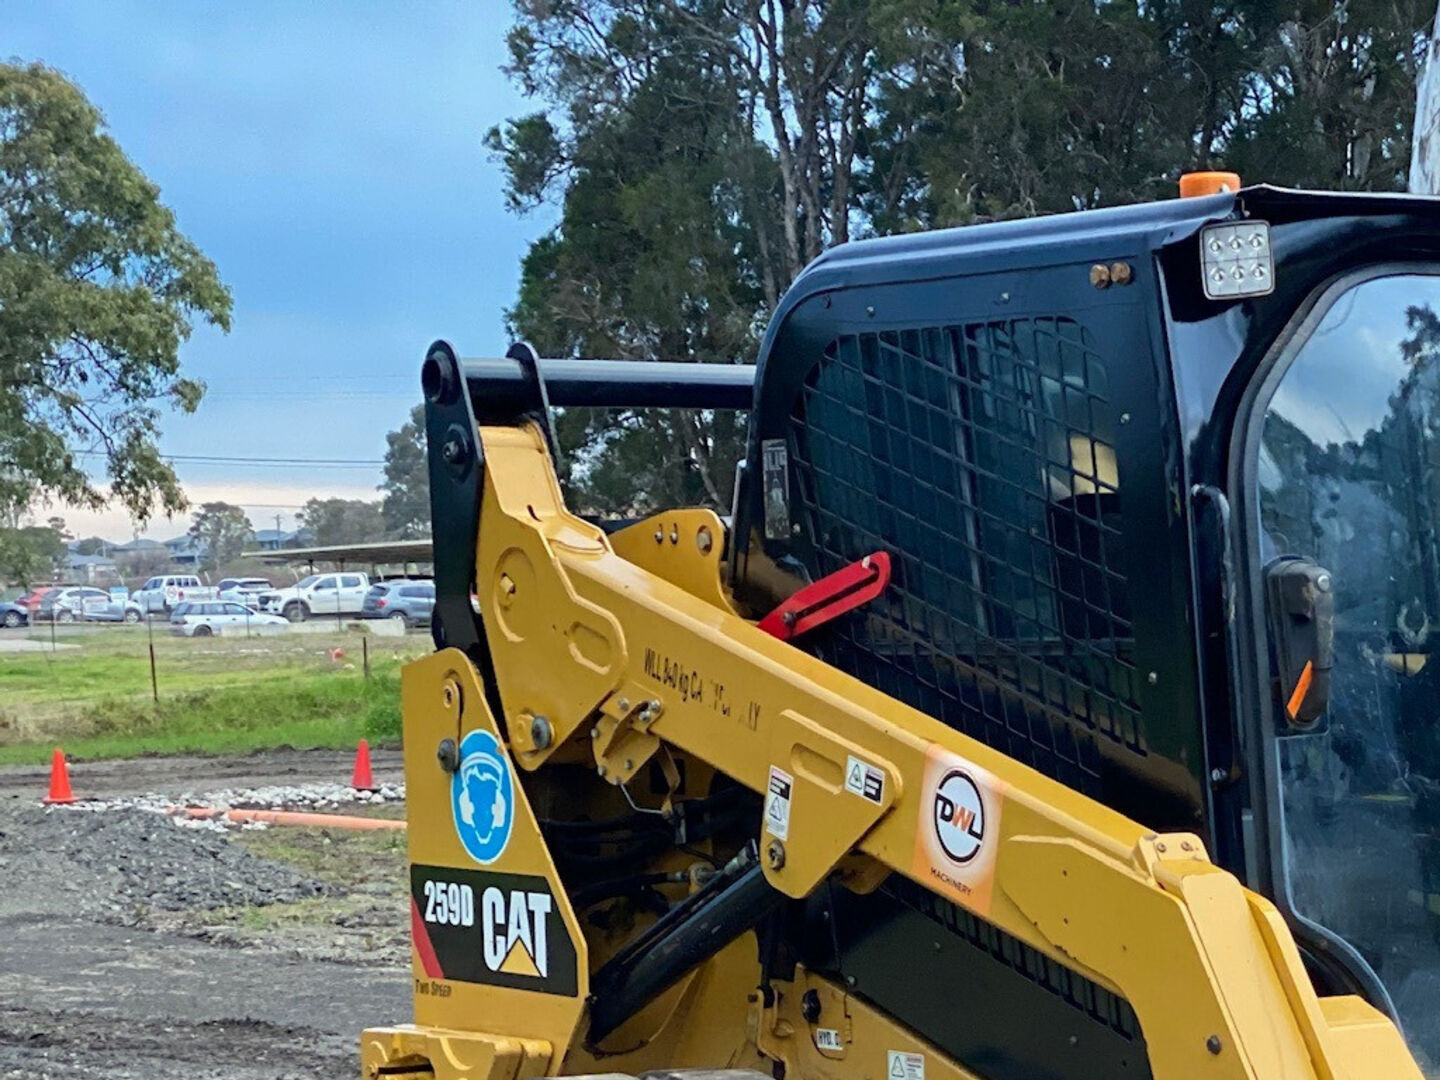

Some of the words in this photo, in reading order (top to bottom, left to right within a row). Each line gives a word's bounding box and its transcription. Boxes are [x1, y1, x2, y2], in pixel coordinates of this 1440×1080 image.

[936, 792, 983, 841] DWL
[930, 866, 972, 896] MACHINERY
[424, 880, 474, 926] 259D
[482, 887, 551, 978] CAT
